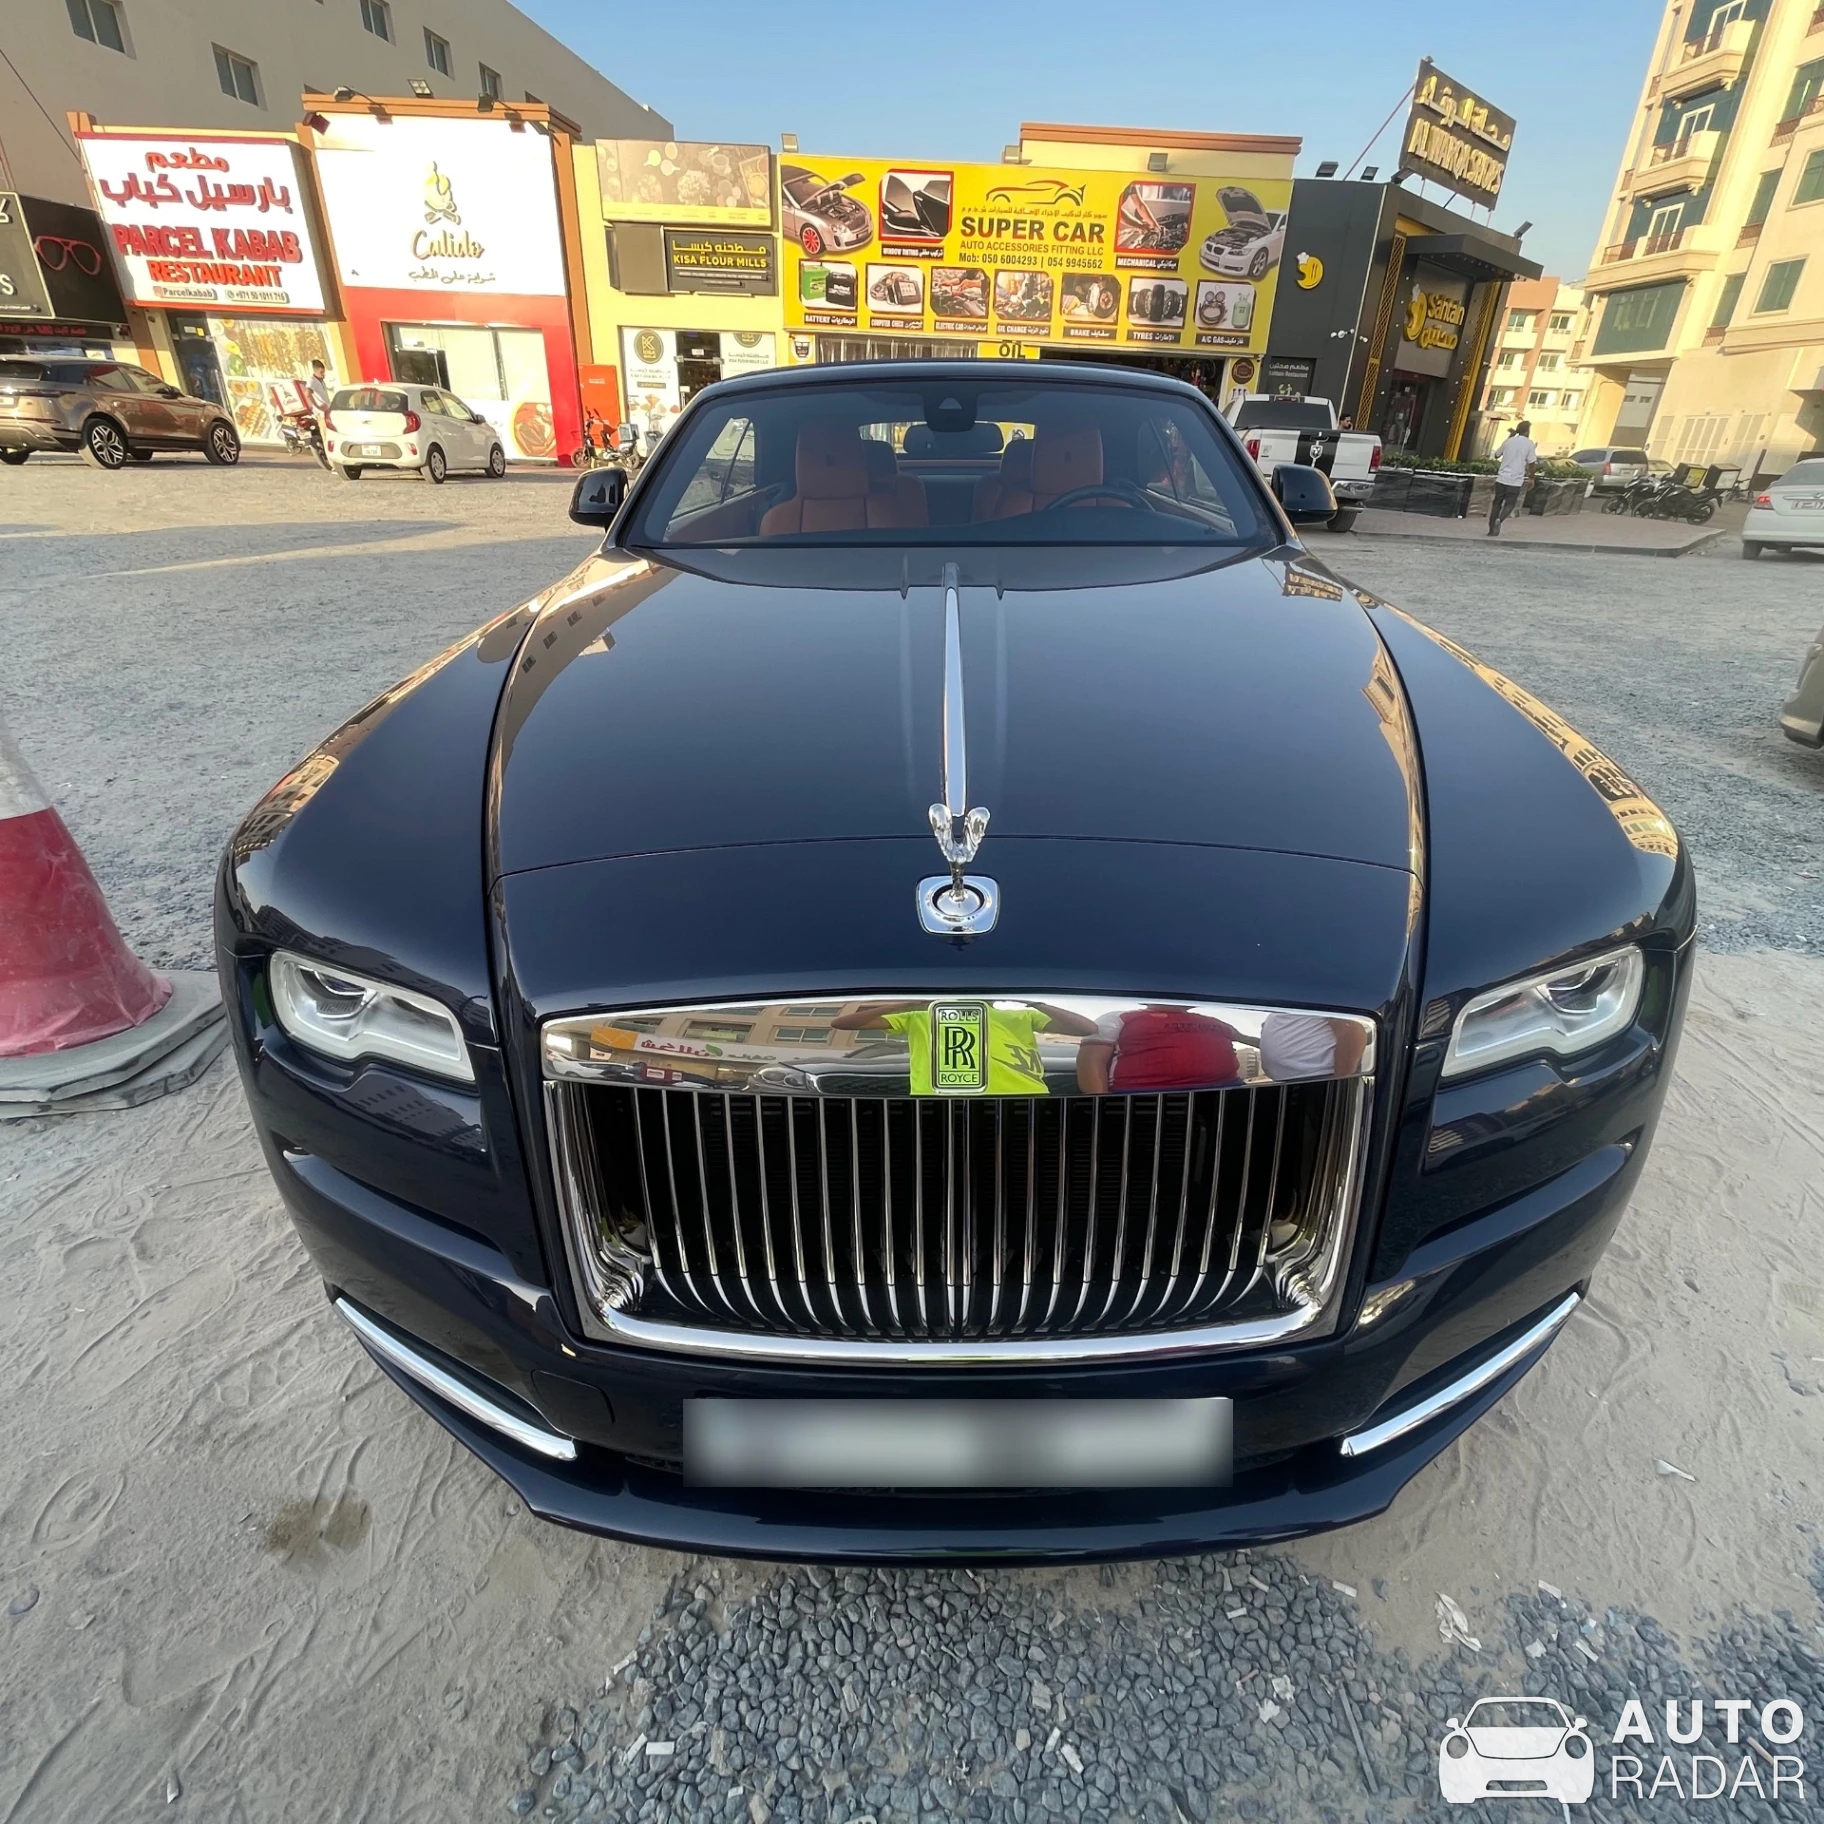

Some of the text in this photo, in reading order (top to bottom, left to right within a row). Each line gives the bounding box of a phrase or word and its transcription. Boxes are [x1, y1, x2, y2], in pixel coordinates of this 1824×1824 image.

[1408, 118, 1430, 159] AL
[145, 147, 230, 173] مطعم
[99, 172, 293, 214] بارسيل كباب
[960, 216, 1105, 244] SUPER CAR
[111, 223, 303, 263] PARCEL KABAB
[412, 229, 485, 260] Calido
[672, 240, 713, 255] كيسا
[960, 240, 1104, 256] AUTO ACCESSORIES FITTING LLC
[673, 254, 767, 268] KISA FLOUR MILLS
[959, 252, 980, 263] Mob:
[981, 253, 998, 264] 050
[1000, 254, 1038, 266] 6004293
[1047, 256, 1063, 267] 054
[1117, 257, 1157, 268] MECHANICAL
[146, 260, 283, 287] RESTAURANT
[163, 286, 213, 298] Parcelkabab
[251, 292, 259, 300] 50
[805, 314, 831, 323] BATTERY
[997, 325, 1028, 334] OIL CHANGE
[1070, 328, 1091, 337] BRAKE
[1132, 331, 1153, 340] TYRES
[1212, 336, 1224, 344] GAS
[998, 341, 1026, 359] OIL
[1290, 363, 1310, 371] مطعم
[940, 1010, 978, 1021] ROLLS
[940, 1073, 978, 1083] ROYCE
